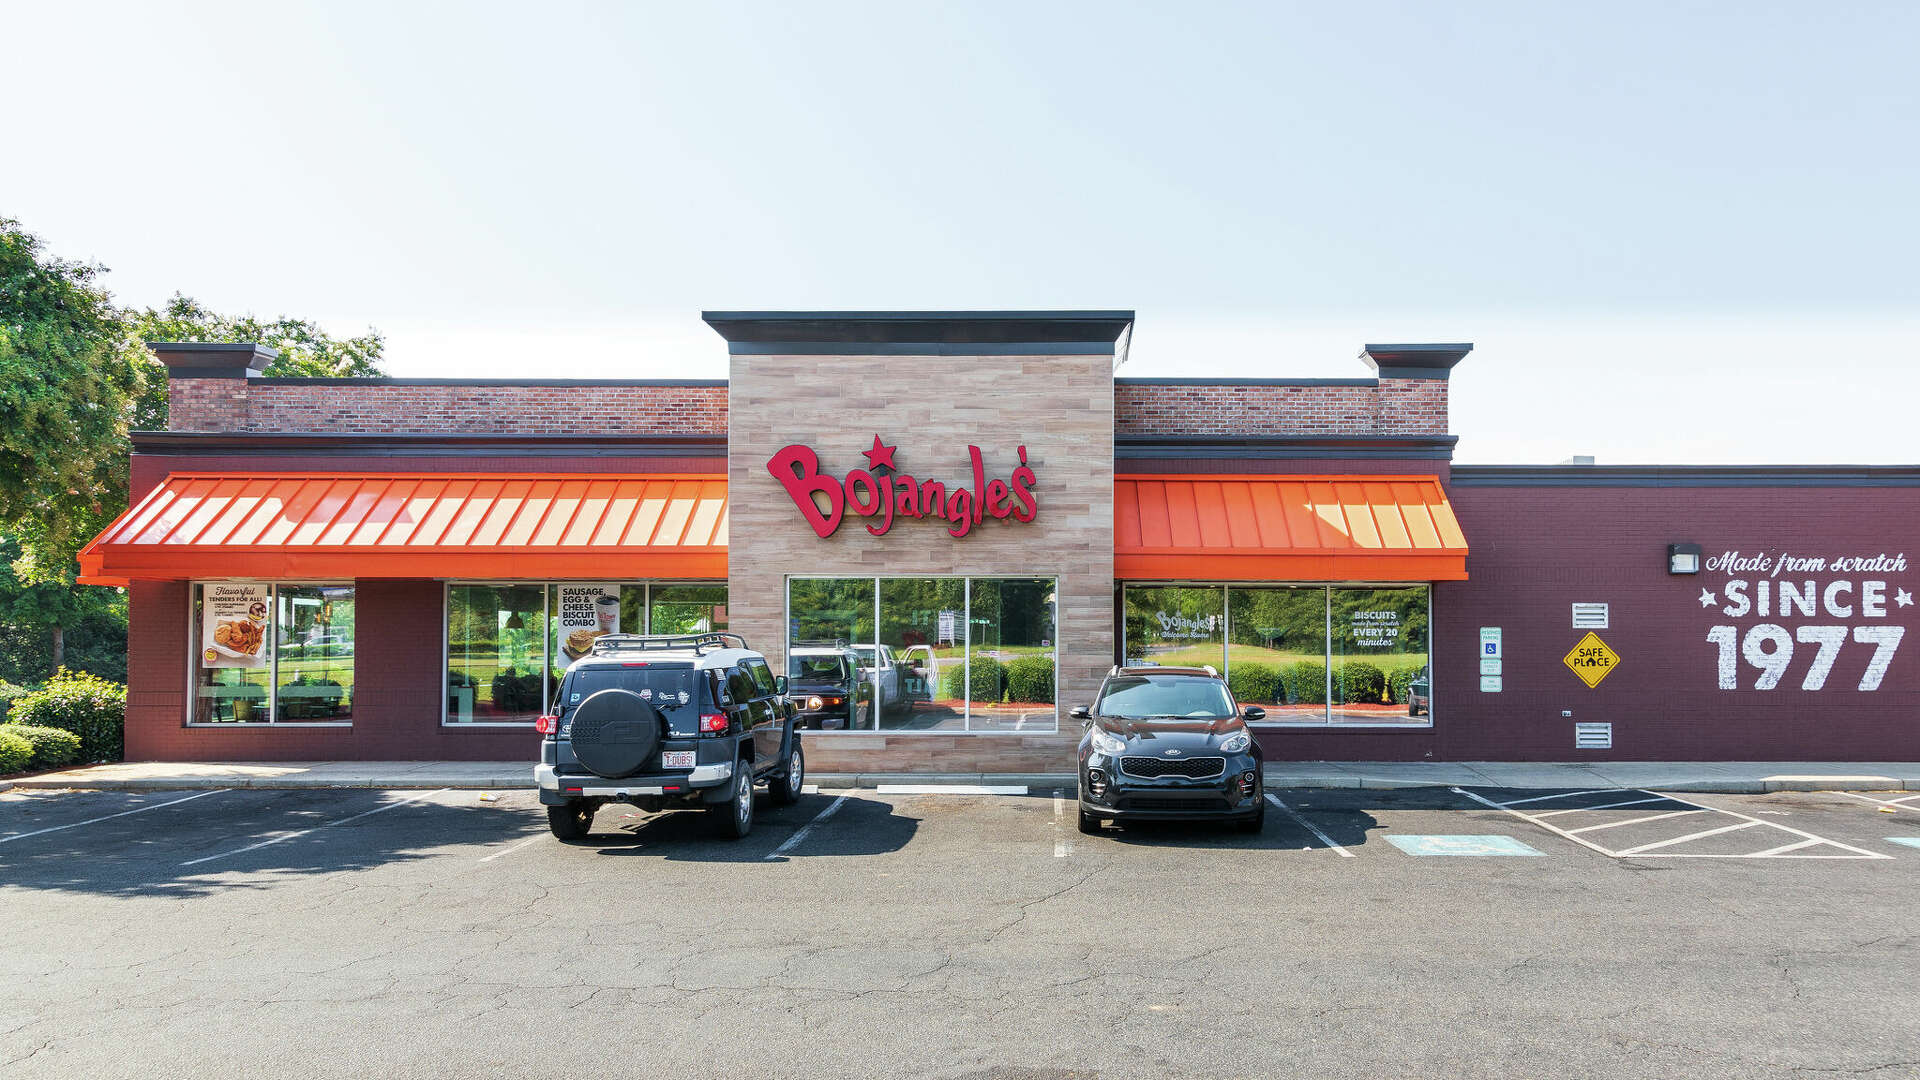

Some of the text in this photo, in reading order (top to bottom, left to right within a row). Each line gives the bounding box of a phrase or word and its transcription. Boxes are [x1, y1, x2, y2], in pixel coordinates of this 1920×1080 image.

[1705, 551, 1907, 578] Made from scratch
[216, 586, 255, 598] Flavorful
[562, 588, 607, 597] SAUSAGE,
[1722, 579, 1887, 617] SINCE
[562, 603, 594, 611] CHEESE
[562, 611, 596, 619] BISCUIT
[1354, 611, 1397, 619] BISCUITS
[562, 619, 596, 627] COMBO
[1353, 628, 1398, 636] EVERY 20
[1357, 638, 1393, 646] minutes
[1578, 648, 1604, 657] SAFE
[1706, 623, 1906, 692] 1977
